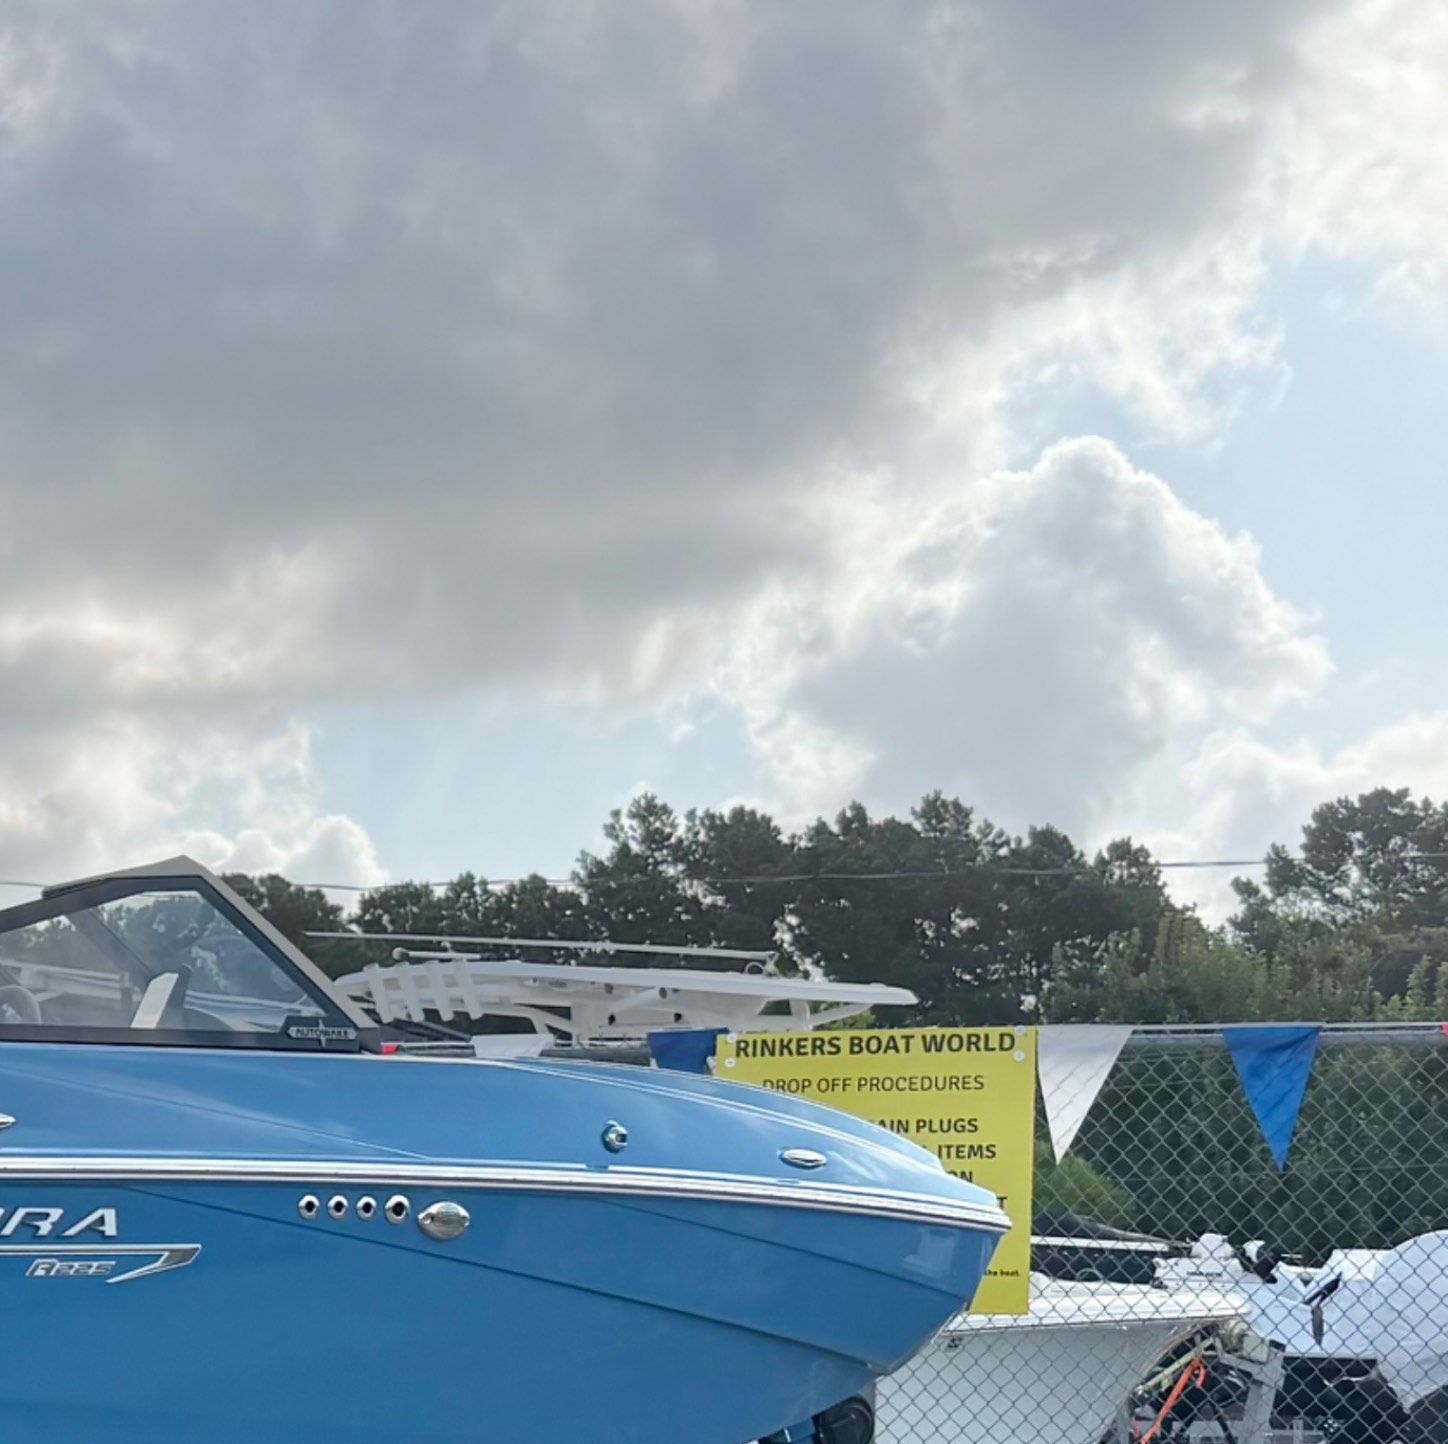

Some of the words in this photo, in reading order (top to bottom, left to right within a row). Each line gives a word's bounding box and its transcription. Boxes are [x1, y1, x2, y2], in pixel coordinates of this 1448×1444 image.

[734, 1036, 842, 1058] RINKERS
[849, 1034, 915, 1055] BOAT
[922, 1032, 1016, 1053] WORLD
[762, 1078, 812, 1094] DROP
[817, 1077, 852, 1093] OFF
[857, 1074, 985, 1092] PROCEDURES
[915, 1117, 979, 1133] PLUGS
[937, 1143, 997, 1159] ITEMS
